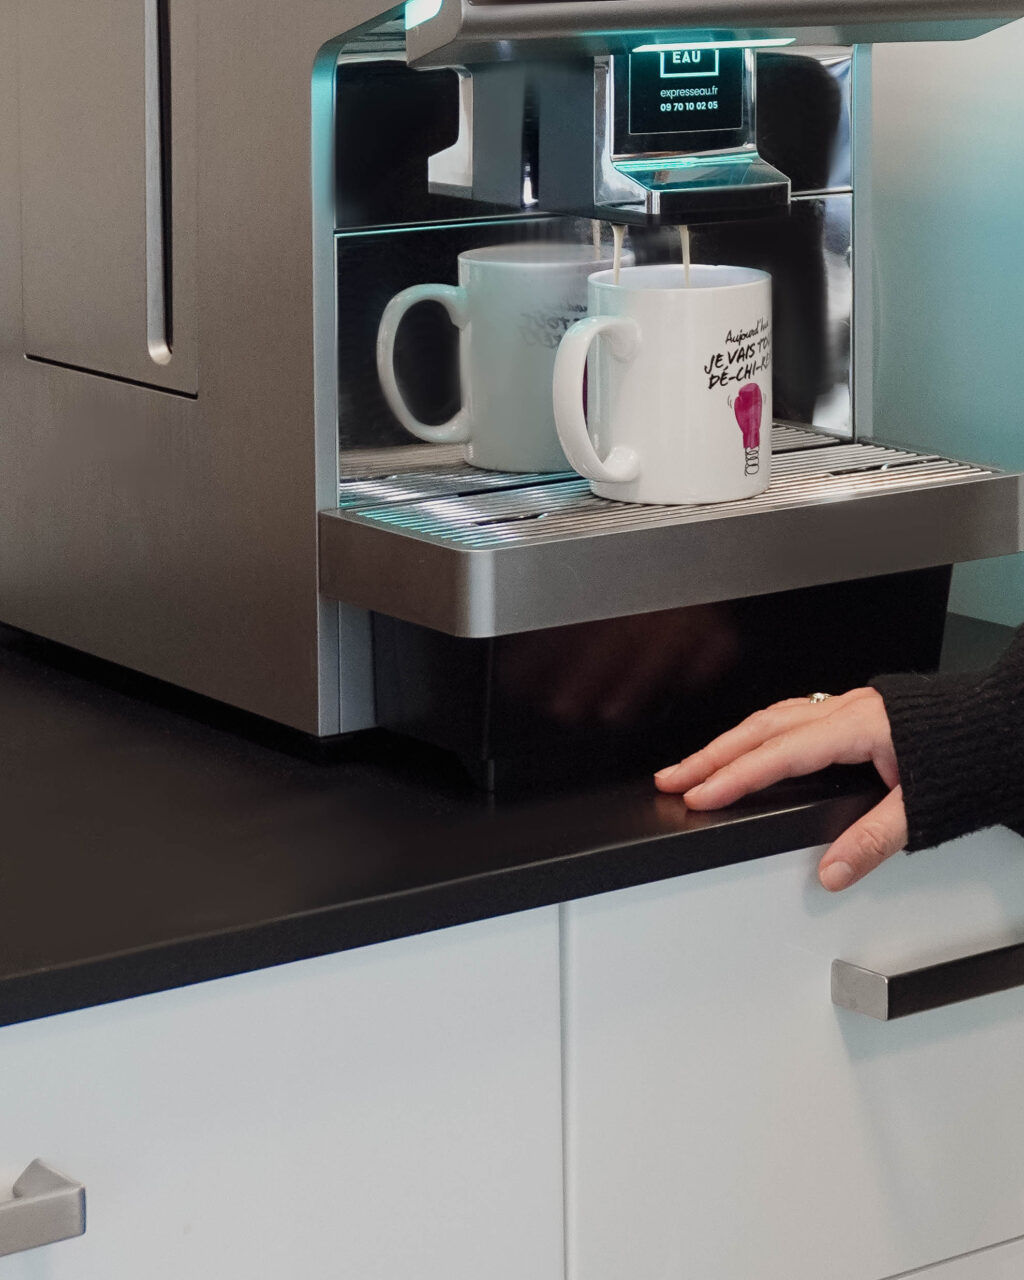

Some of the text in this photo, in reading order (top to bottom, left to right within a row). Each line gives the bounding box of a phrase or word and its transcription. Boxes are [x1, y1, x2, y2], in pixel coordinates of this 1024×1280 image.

[672, 50, 701, 63] EAU
[660, 85, 718, 100] expresseau.fr
[660, 101, 718, 111] 09 70 10 02 05
[704, 353, 724, 374] JE
[727, 343, 756, 365] VAIS
